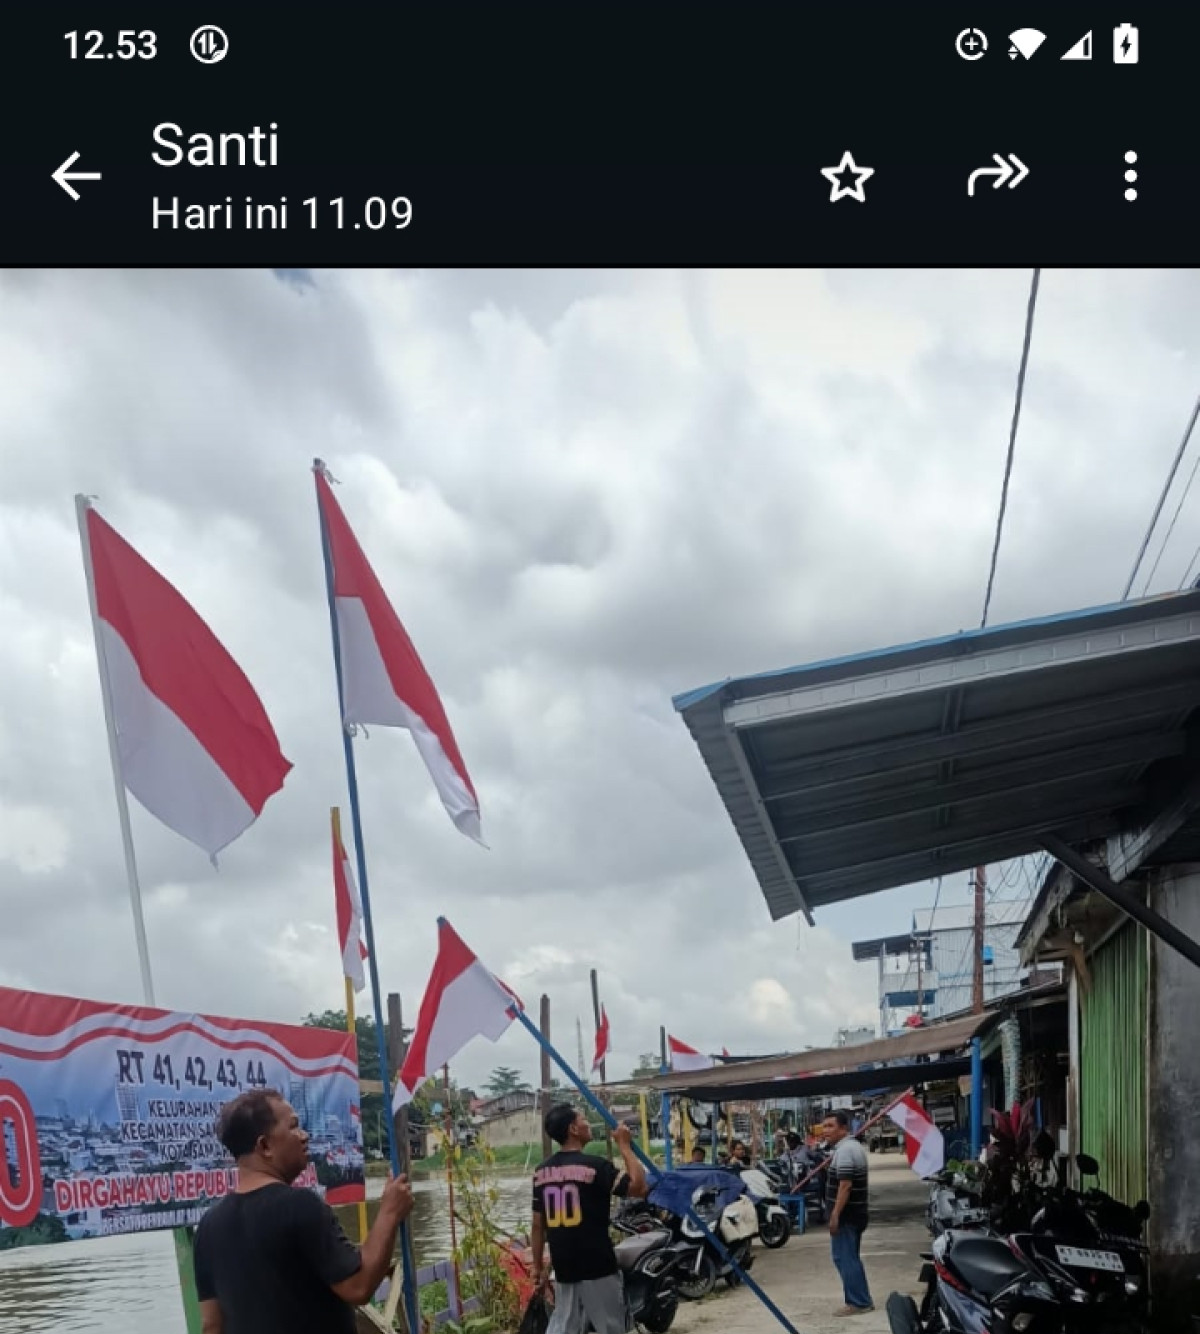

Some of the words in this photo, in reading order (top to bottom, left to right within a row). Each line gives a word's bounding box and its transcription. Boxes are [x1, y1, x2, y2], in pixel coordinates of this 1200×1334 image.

[116, 1049, 145, 1084] RT
[153, 1053, 181, 1091] 41,
[184, 1056, 213, 1092] 42,
[216, 1058, 243, 1092] 43,
[246, 1060, 268, 1088] 44
[148, 1099, 218, 1118] KELURAHAN
[121, 1121, 196, 1140] KECAMATAN
[160, 1143, 192, 1161] KOTA
[54, 1171, 171, 1213] DIRGAHAYU
[543, 1183, 582, 1228] 00
